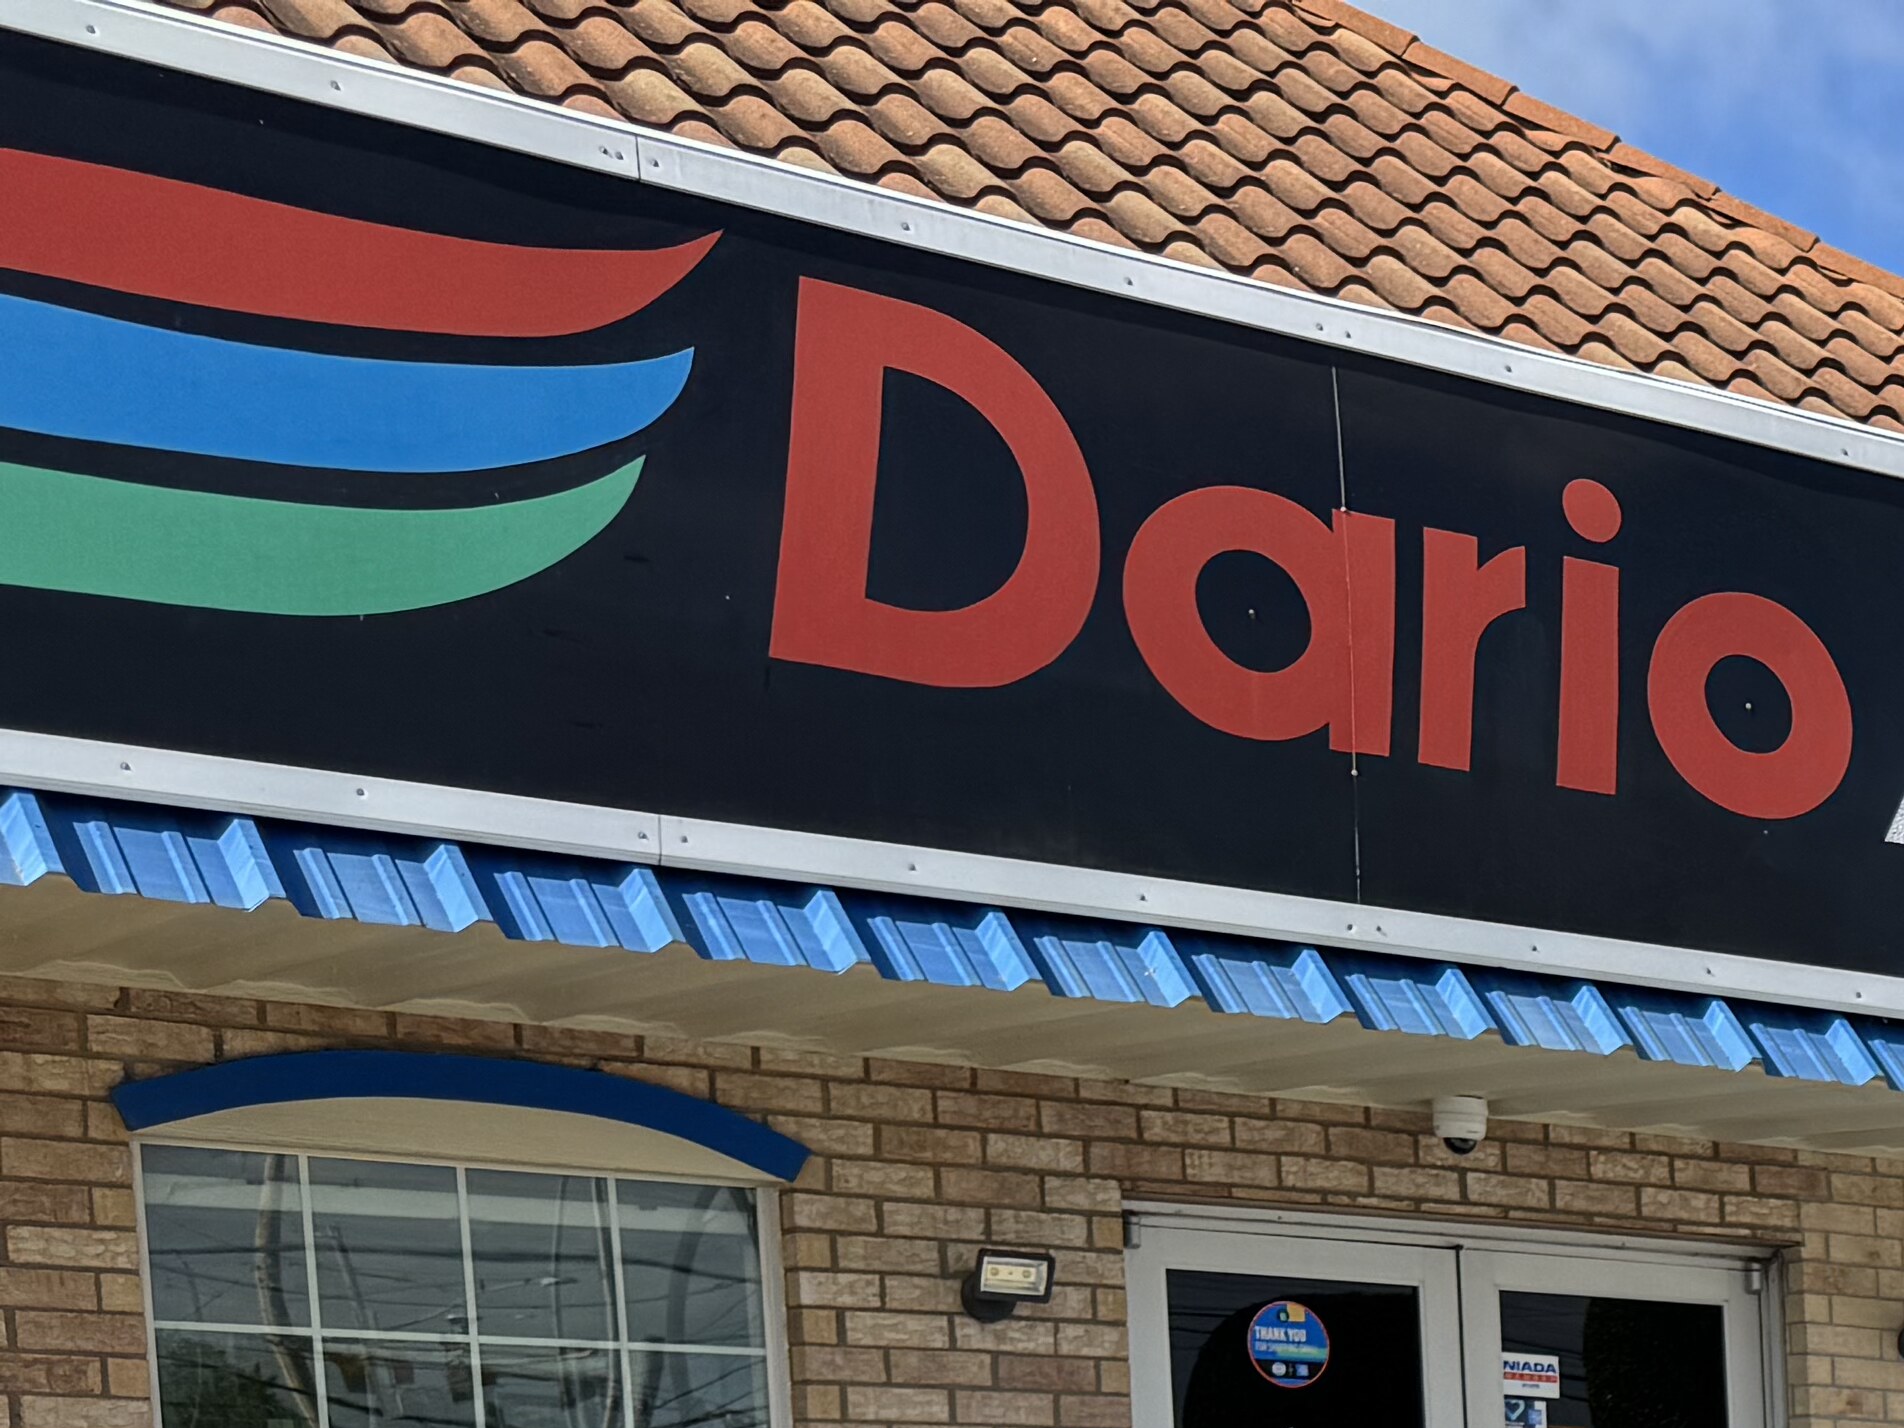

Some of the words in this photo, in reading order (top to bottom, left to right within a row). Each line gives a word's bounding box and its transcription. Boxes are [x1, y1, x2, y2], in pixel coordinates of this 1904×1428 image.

[769, 275, 1853, 820] Dario
[1255, 1325, 1286, 1341] THANK
[1287, 1328, 1307, 1342] YOU
[1503, 1360, 1557, 1374] NIADA
